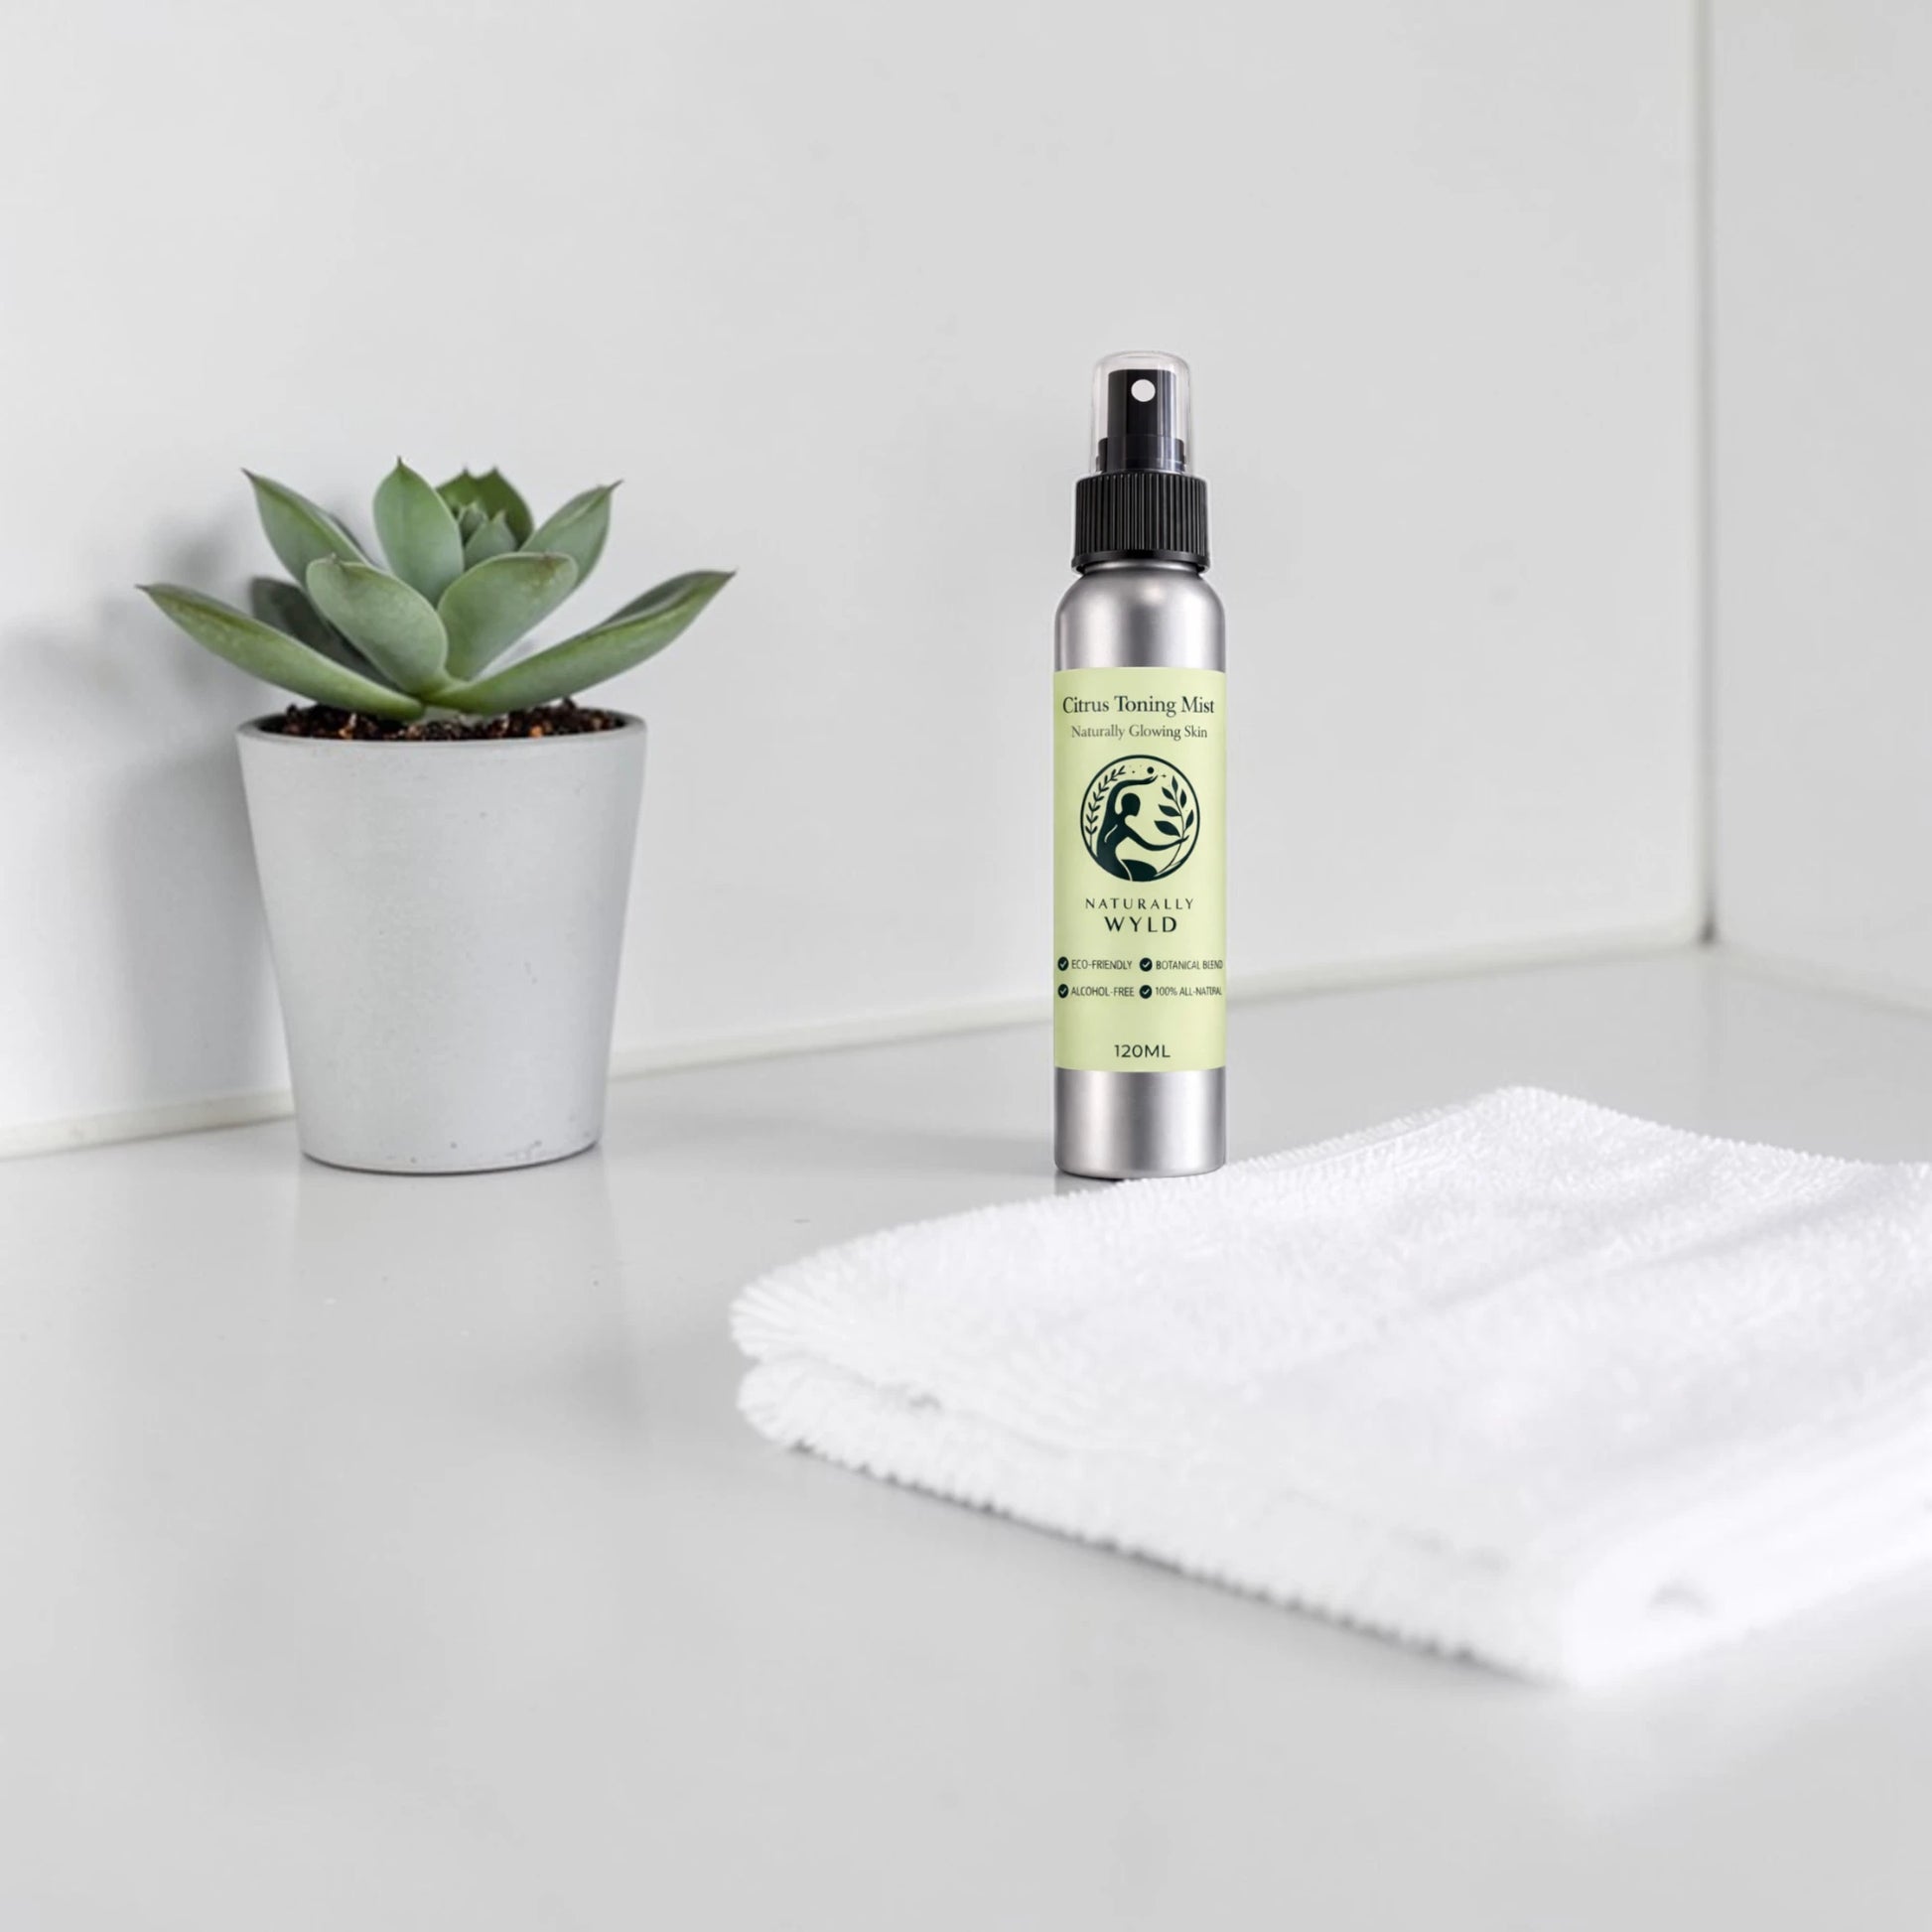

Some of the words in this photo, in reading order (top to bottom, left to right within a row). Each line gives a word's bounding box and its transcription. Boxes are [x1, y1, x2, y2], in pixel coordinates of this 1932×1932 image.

[1063, 696, 1109, 713] Citrus
[1114, 695, 1176, 718] Toning
[1181, 696, 1214, 714] Mist
[1071, 725, 1125, 740] Naturally
[1129, 724, 1181, 741] Glowing
[1184, 725, 1207, 739] Skin
[1085, 897, 1193, 909] NATURALLY
[1103, 916, 1177, 932] WYLD
[1071, 959, 1133, 970] ECO-FRIENDLY
[1156, 960, 1200, 970] BOTANICAL
[1202, 959, 1223, 970] BLEND
[1071, 986, 1135, 997] ALCOHOL-FREE
[1155, 986, 1177, 997] 100%
[1114, 1043, 1172, 1057] 120ML
